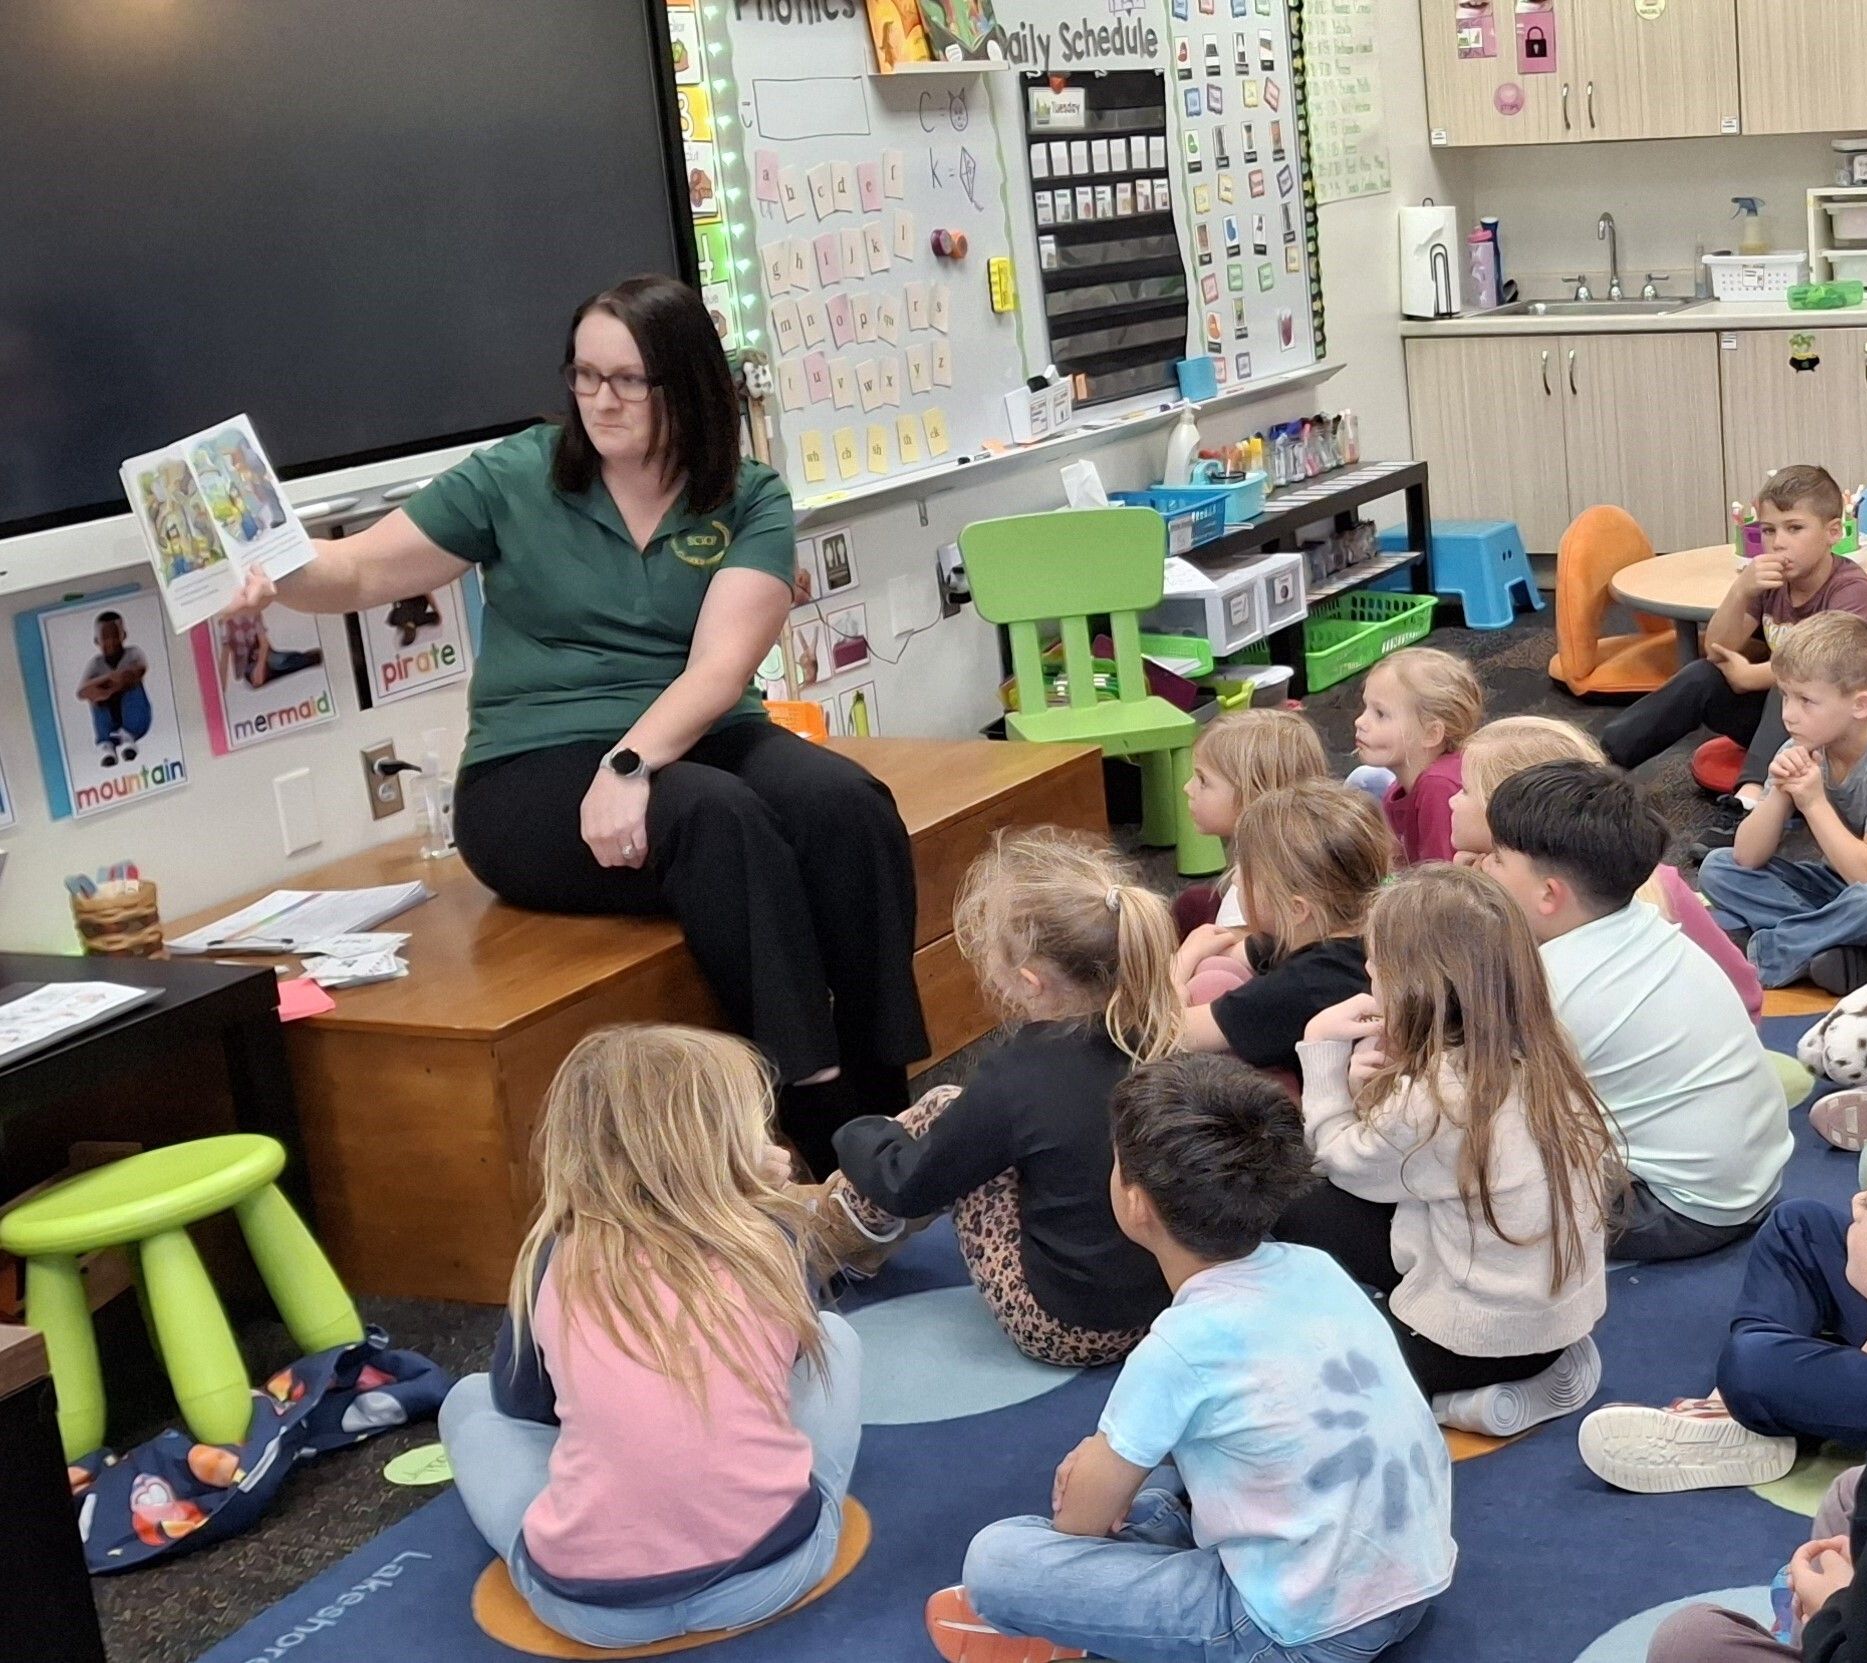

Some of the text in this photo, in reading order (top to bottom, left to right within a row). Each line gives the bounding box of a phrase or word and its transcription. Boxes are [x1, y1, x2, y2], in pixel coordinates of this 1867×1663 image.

[1059, 17, 1158, 63] Schedule
[763, 169, 770, 181] a
[785, 184, 795, 200] b
[817, 186, 825, 198] c
[838, 176, 846, 193] d
[866, 181, 873, 193] e
[796, 252, 803, 270] h
[871, 238, 880, 253] k
[780, 319, 792, 333] m
[807, 314, 815, 327] n
[836, 315, 844, 327] o
[860, 313, 867, 329] p
[914, 300, 919, 312] r
[936, 301, 942, 312] s
[813, 371, 821, 383] u
[837, 377, 844, 389] v
[864, 379, 873, 392] w
[886, 375, 893, 387] x
[913, 363, 920, 378] y
[938, 356, 944, 368] z
[380, 641, 457, 691] pirate
[233, 691, 331, 740] mermaid
[75, 757, 184, 810] mountain
